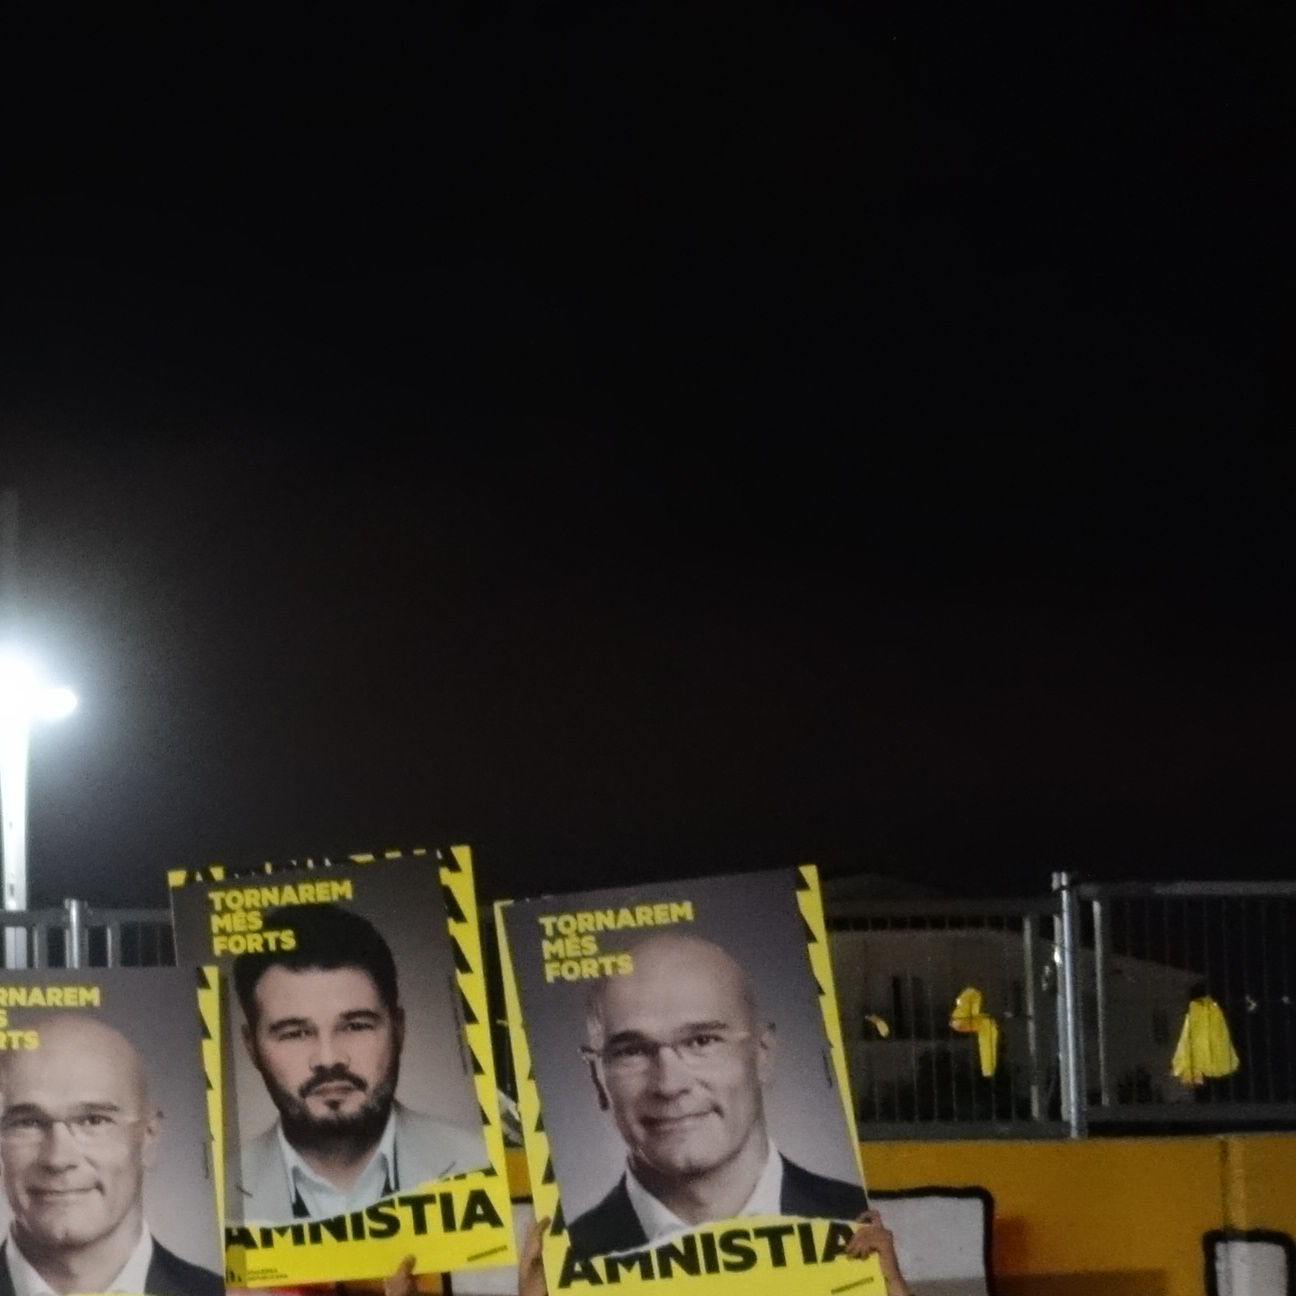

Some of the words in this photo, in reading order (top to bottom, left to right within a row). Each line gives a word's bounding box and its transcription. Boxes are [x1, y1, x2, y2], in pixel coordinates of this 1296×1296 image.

[210, 880, 353, 910] TORNAREM
[211, 905, 264, 933] MÉS
[539, 901, 694, 933] TORNAREM
[212, 931, 296, 956] FORTS
[542, 933, 597, 959] MÉS
[544, 954, 634, 984] FORTS
[224, 1188, 503, 1253] AMNISTIA
[558, 1222, 859, 1289] AMNISTIA
